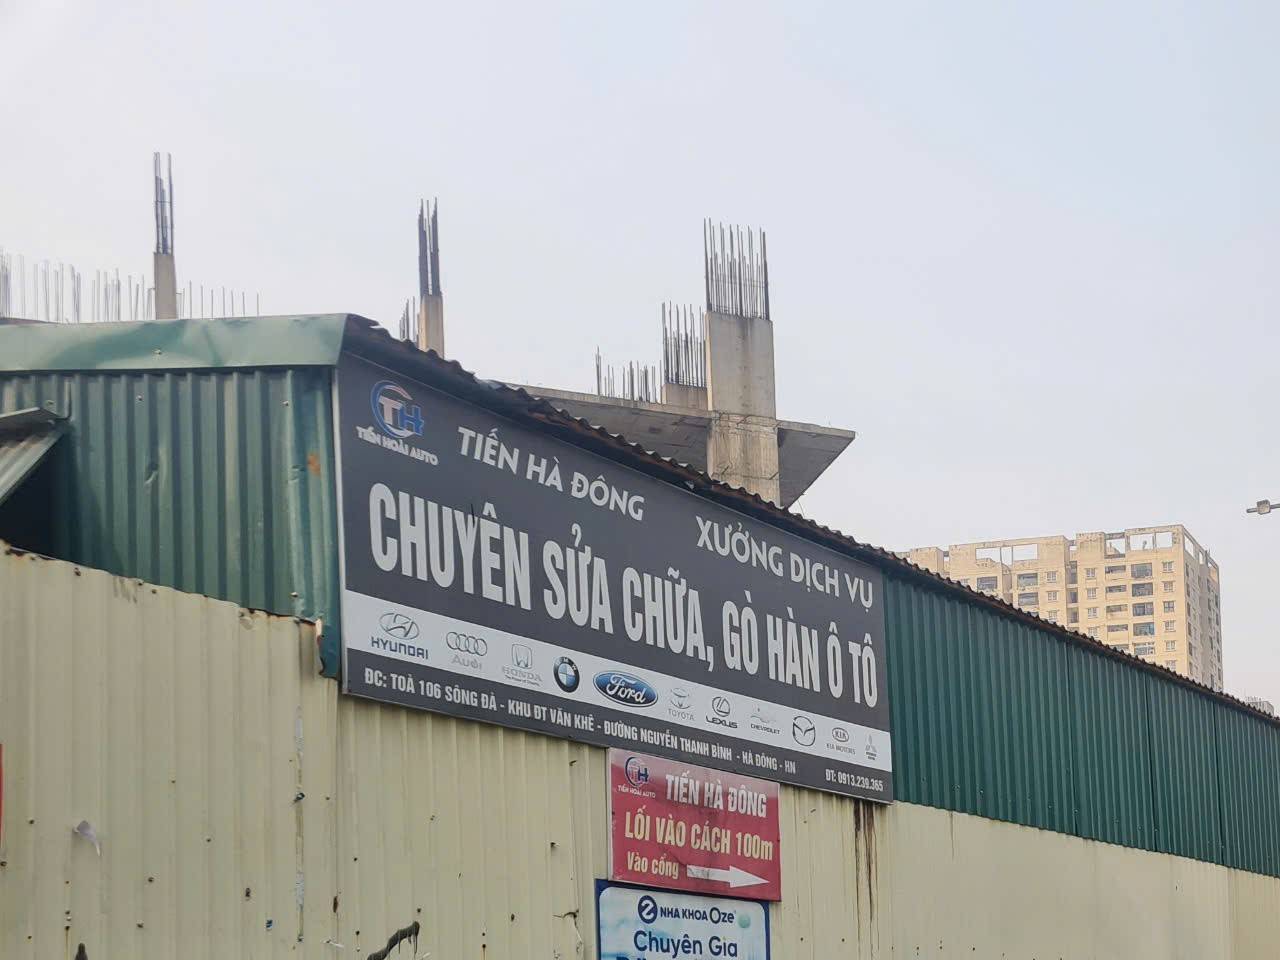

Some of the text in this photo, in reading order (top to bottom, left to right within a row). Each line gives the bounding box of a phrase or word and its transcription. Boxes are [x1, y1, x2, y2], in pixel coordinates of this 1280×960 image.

[409, 447, 439, 466] AUTO
[457, 427, 873, 613] TIẾN HÀ ĐÔNG XƯỞNG DỊCH VỤ
[368, 482, 878, 708] CHUYÊN SỬA CHỮA, GÒ HÀN Ô TÔ
[371, 636, 429, 660] HYUNDAI
[605, 674, 647, 703] Ford
[364, 667, 796, 774] ĐC: TOÀ 106 SÔNG ĐÀ KHU ĐT VĂN KHÊ ĐƯỜNG NGUYỄN THANH BÌNH HÀ ĐÔNG HN
[668, 708, 695, 721] TOYOTA
[705, 715, 738, 729] LEXUS
[750, 723, 780, 735] CHEVROLET
[825, 769, 836, 782] ĐT:
[665, 770, 767, 818] TIẾN HÀ ĐÔNG
[624, 805, 773, 861] LỐI VÀO CÁCH 100m
[627, 851, 679, 879] Vào cổng
[660, 906, 735, 924] NHA KHOA Oze
[633, 930, 738, 959] Chuyên Gia
